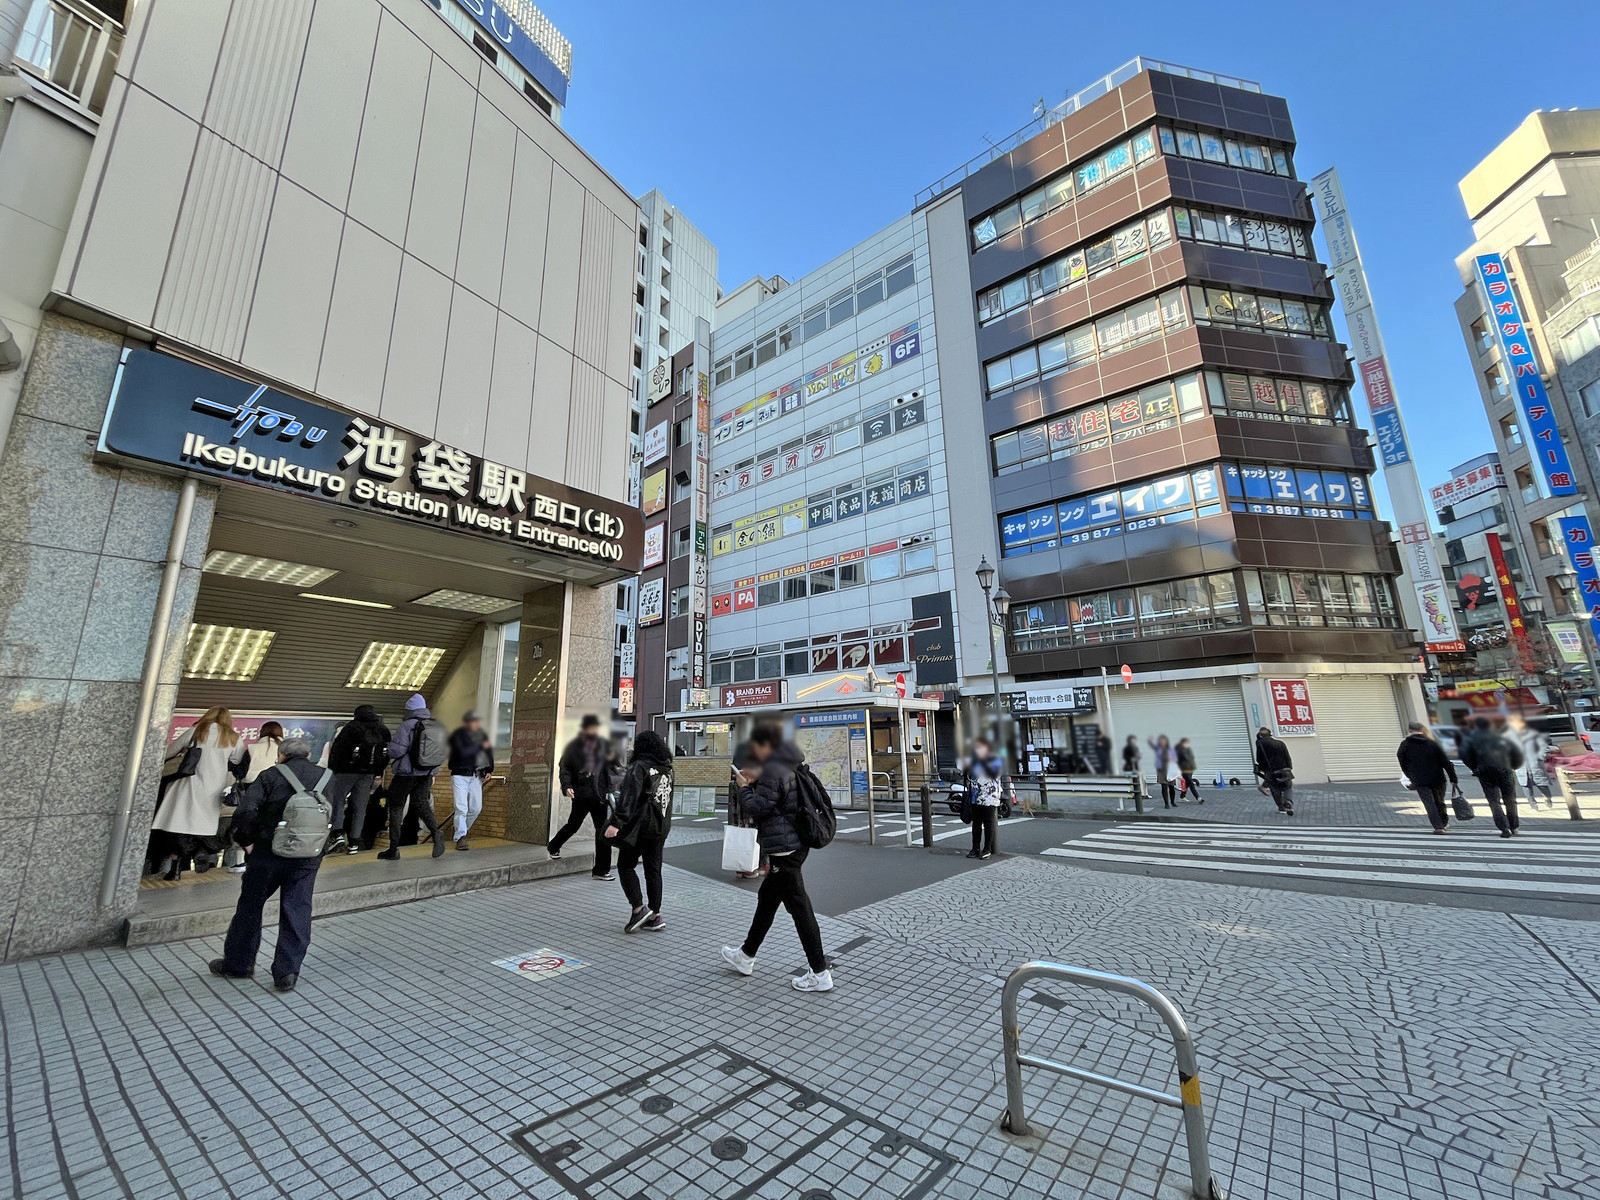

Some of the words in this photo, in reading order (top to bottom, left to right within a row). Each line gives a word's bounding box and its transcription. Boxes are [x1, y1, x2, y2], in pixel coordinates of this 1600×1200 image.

[1214, 303, 1259, 321] Candy
[895, 338, 916, 360] 6F
[1483, 262, 1572, 487] カラオケ&パーティー館
[212, 390, 328, 443] TOBU
[714, 406, 777, 442] インターネット
[1022, 399, 1140, 453] 三越住宅
[1378, 425, 1395, 453] エイワ
[738, 442, 827, 488] カラオケ
[1386, 451, 1407, 464] 3F
[344, 417, 527, 513] 池袋駅
[533, 493, 625, 541] 西口(北)
[1228, 466, 1287, 480] キャッシング
[1432, 466, 1491, 500] 広告主募集
[182, 432, 347, 493] Ikebukuro
[354, 478, 449, 519] Station
[457, 503, 513, 534] West
[517, 519, 624, 562] Entrance(N)
[810, 475, 928, 524] 中国食品友誼商店
[1004, 505, 1086, 535] キャッシング
[1091, 478, 1186, 520] エイワ
[1195, 469, 1213, 500] 3F
[1276, 480, 1345, 502] エイワ
[1351, 476, 1366, 504] 3F
[738, 591, 754, 605] PA
[916, 654, 954, 664] Primus
[736, 687, 754, 697] BRAND
[755, 685, 772, 695] PEACE
[1273, 684, 1306, 701] 古着
[1277, 705, 1311, 722] 買取
